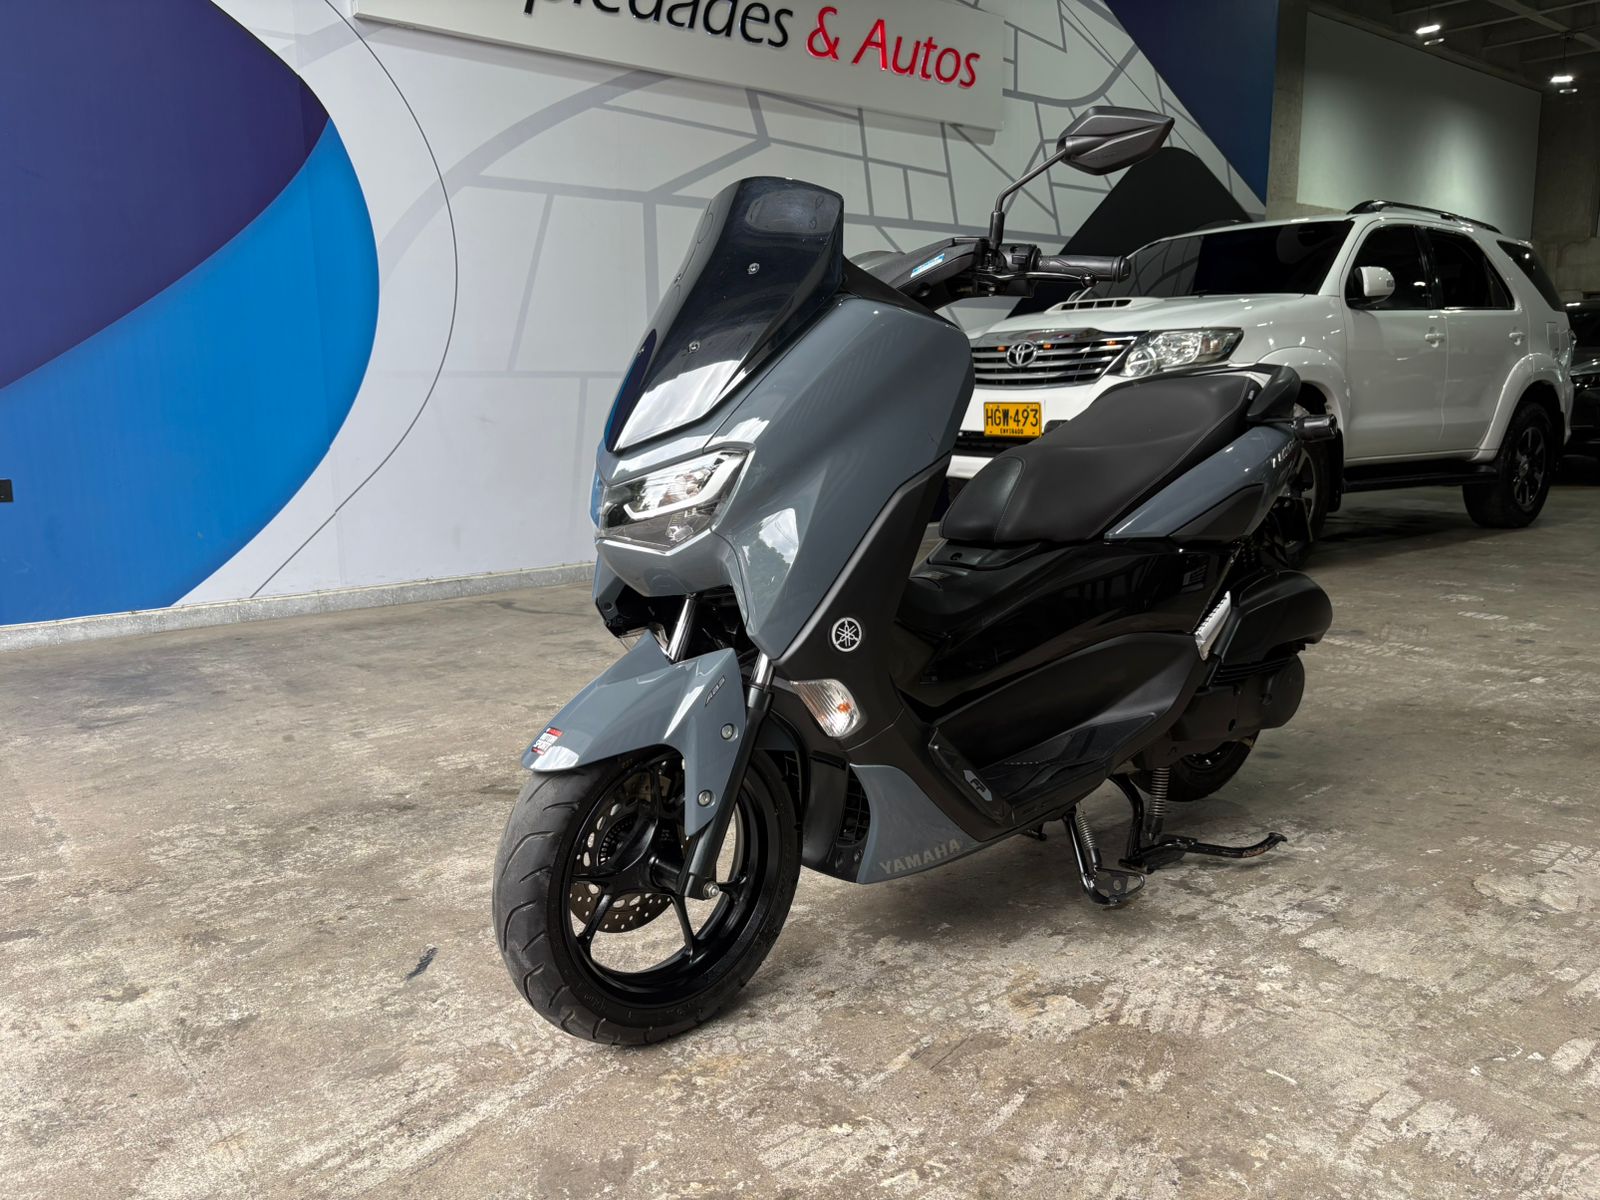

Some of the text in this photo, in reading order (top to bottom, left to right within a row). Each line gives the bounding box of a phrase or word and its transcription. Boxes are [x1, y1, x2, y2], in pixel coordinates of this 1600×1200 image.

[524, 0, 981, 89] ades & Autos
[880, 838, 961, 875] YAMAHA
